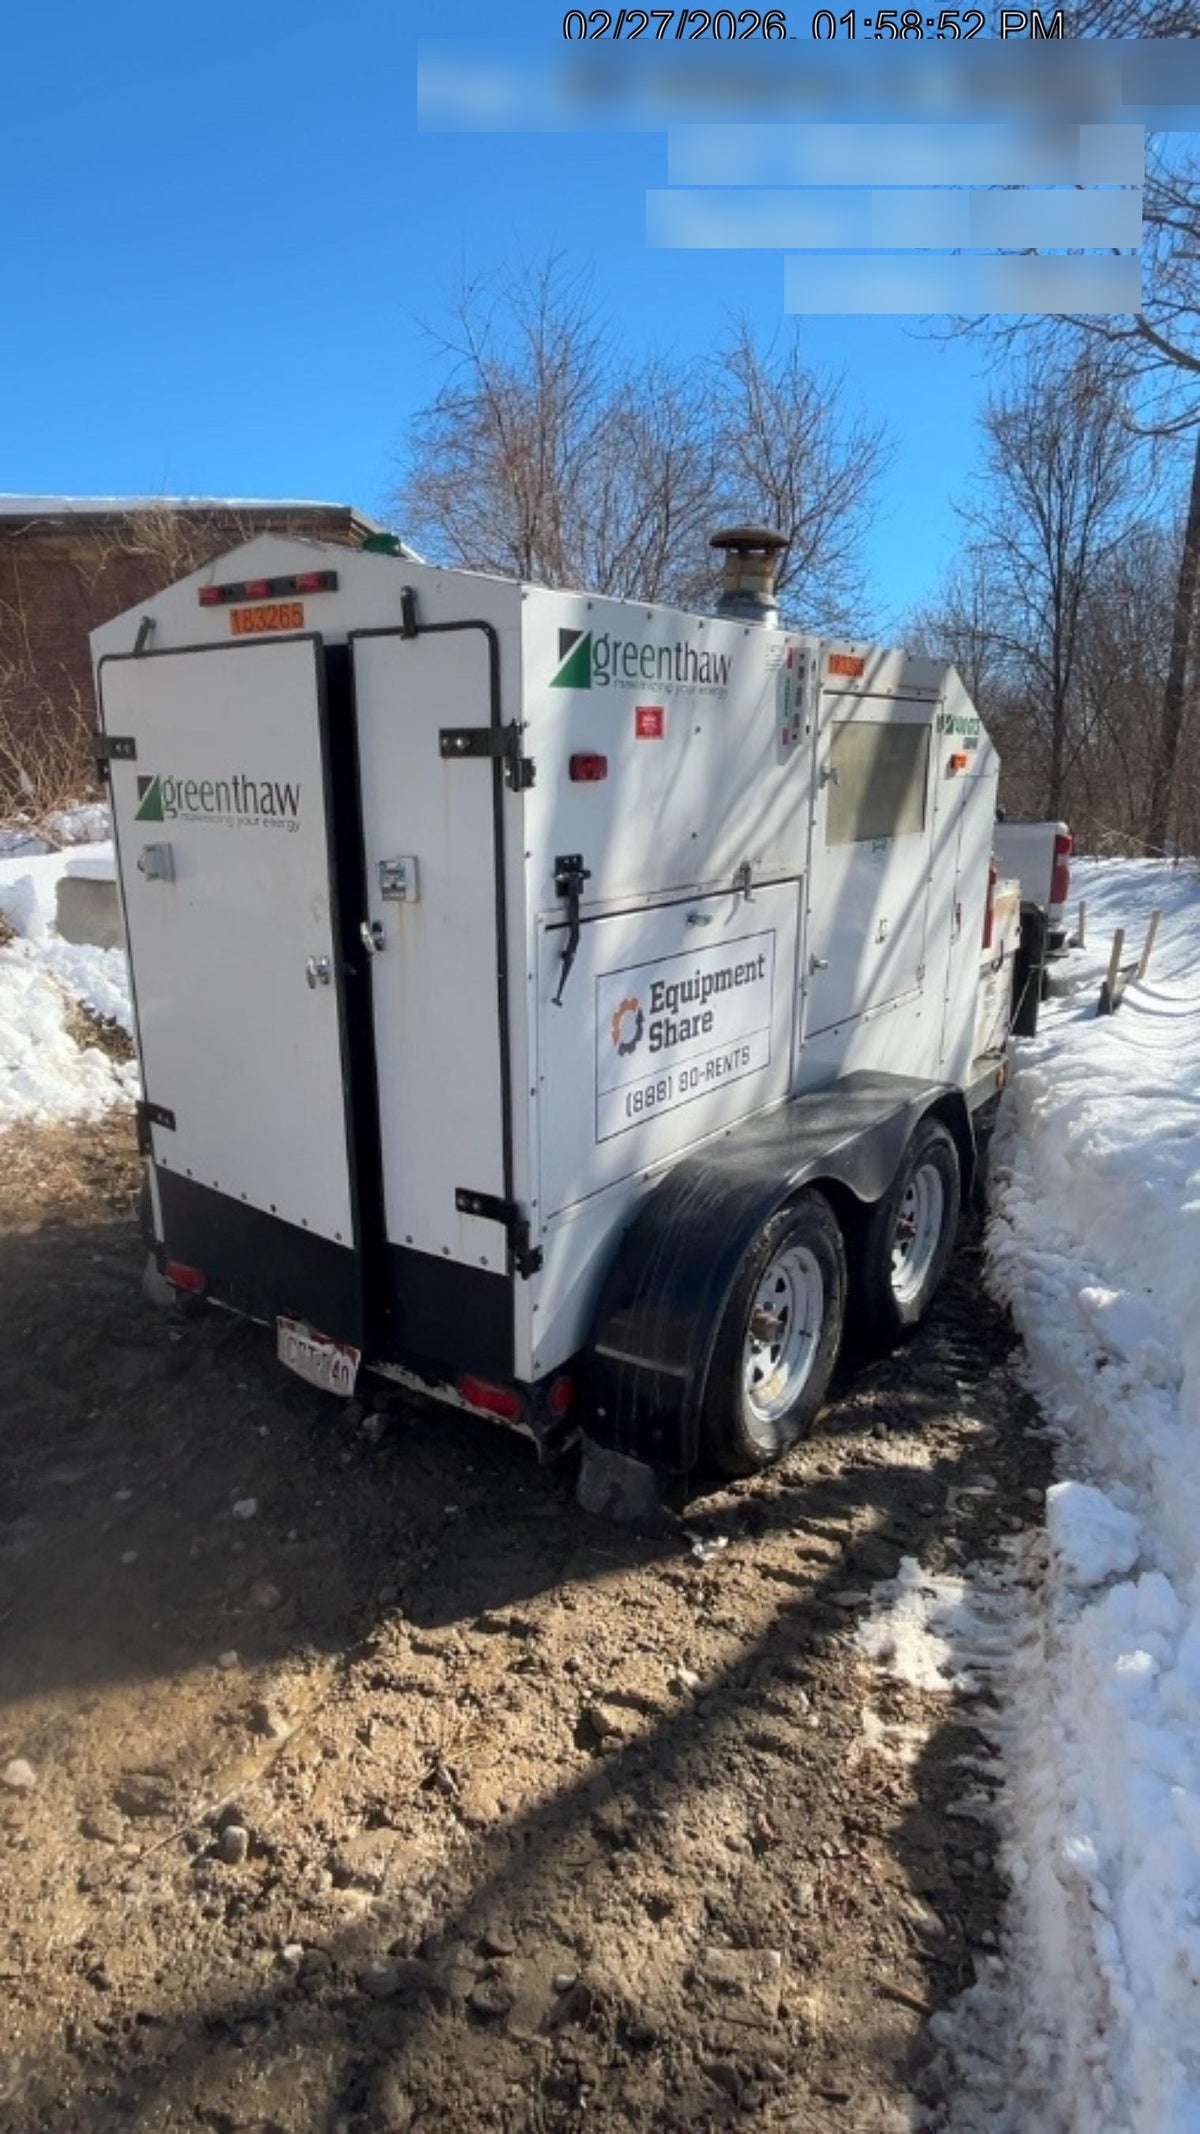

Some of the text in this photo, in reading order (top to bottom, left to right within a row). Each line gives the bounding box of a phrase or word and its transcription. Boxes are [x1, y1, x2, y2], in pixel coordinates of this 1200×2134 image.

[592, 633, 731, 686] greenthaw
[163, 773, 300, 819] greenthaw
[650, 954, 765, 1014] Equipment
[649, 1010, 713, 1053] Share
[626, 1045, 750, 1117] (888) 80-RENTS
